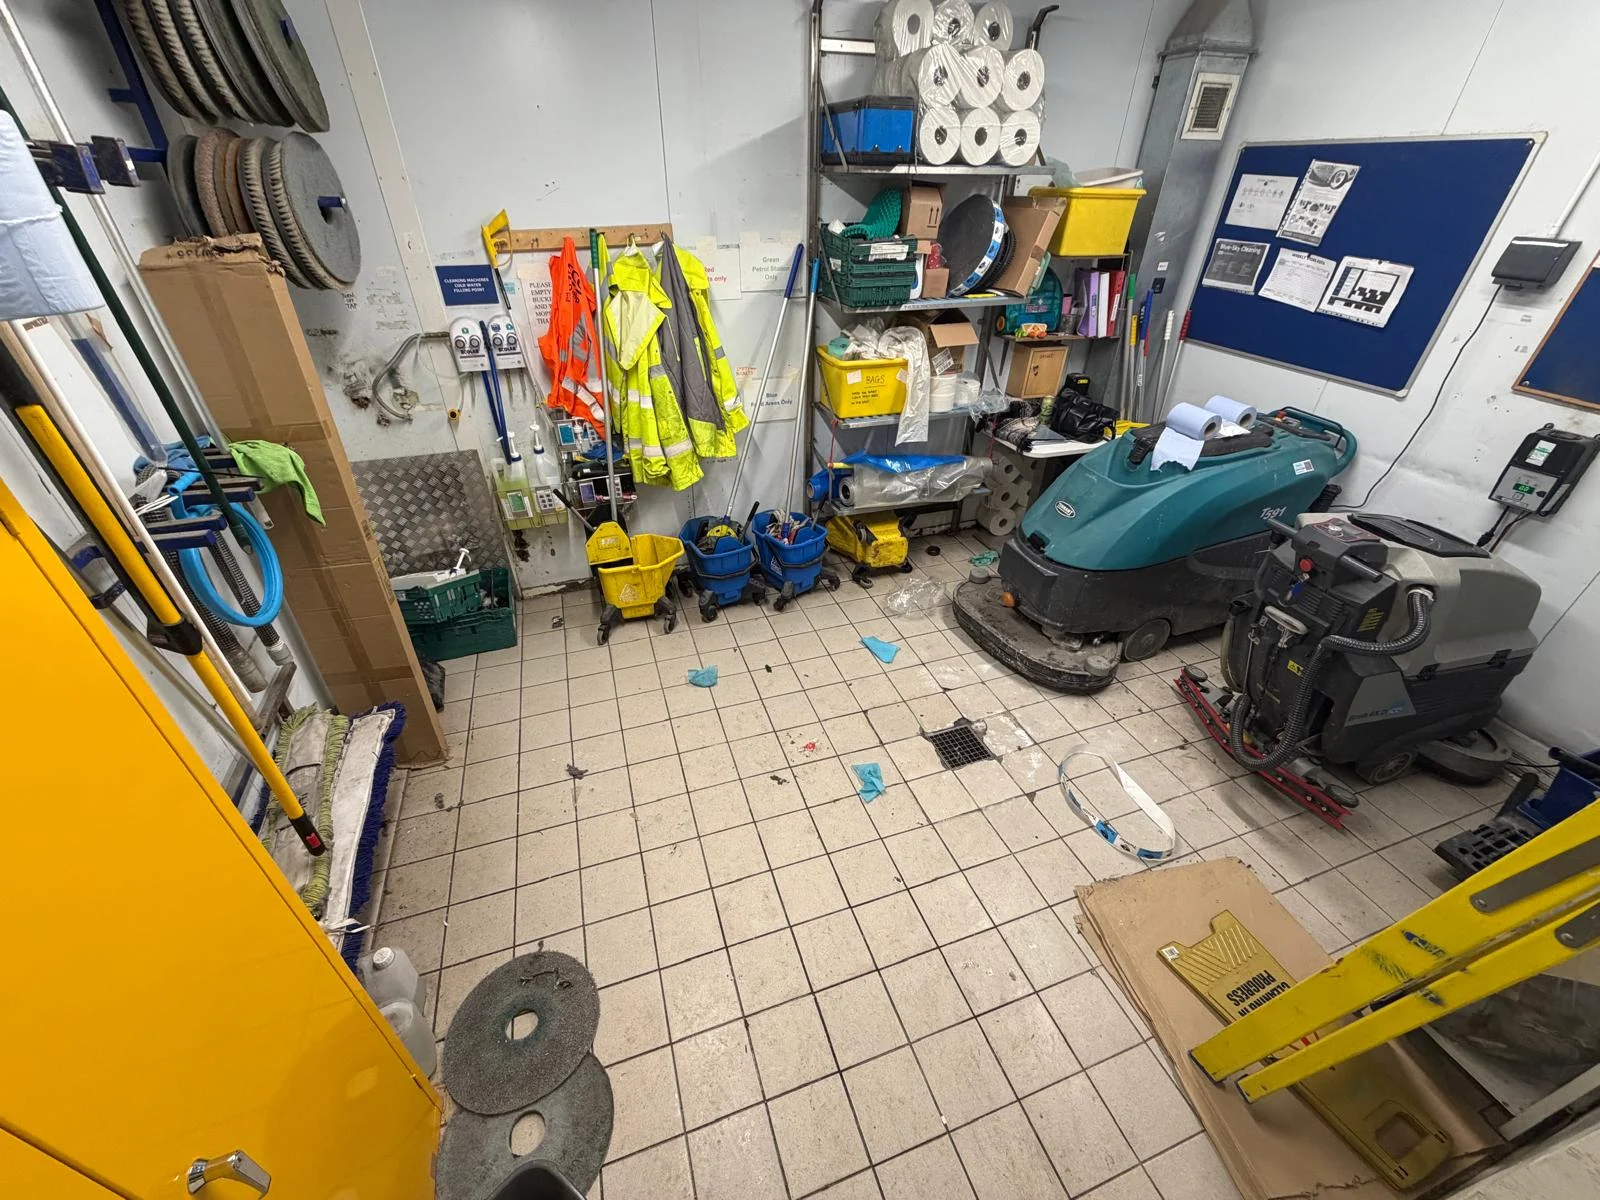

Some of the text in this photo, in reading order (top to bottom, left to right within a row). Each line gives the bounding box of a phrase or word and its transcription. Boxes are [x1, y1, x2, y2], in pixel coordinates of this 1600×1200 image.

[1240, 246, 1262, 256] Cleaning
[713, 274, 727, 284] only
[865, 374, 886, 385] BAGS
[780, 398, 793, 406] Only
[1260, 506, 1288, 520] T591
[1226, 970, 1276, 1006] PROGRESS
